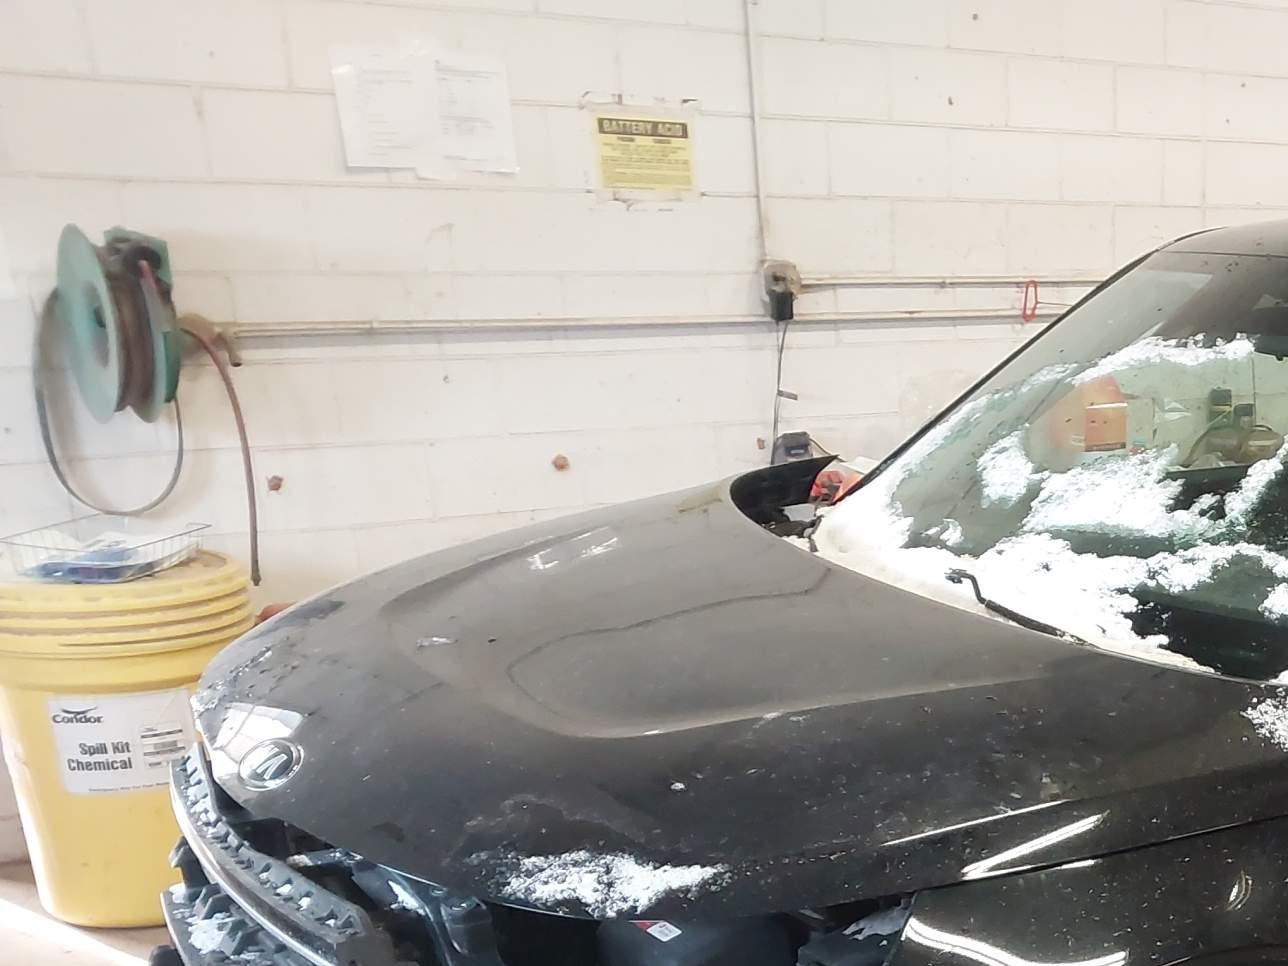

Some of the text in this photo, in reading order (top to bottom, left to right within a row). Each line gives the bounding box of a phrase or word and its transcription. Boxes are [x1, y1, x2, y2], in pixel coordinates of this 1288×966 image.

[602, 120, 683, 136] BATTERY ACID
[52, 713, 104, 724] Condor
[79, 742, 108, 757] Spill
[112, 741, 131, 754] Kit
[67, 757, 133, 772] Chemical
